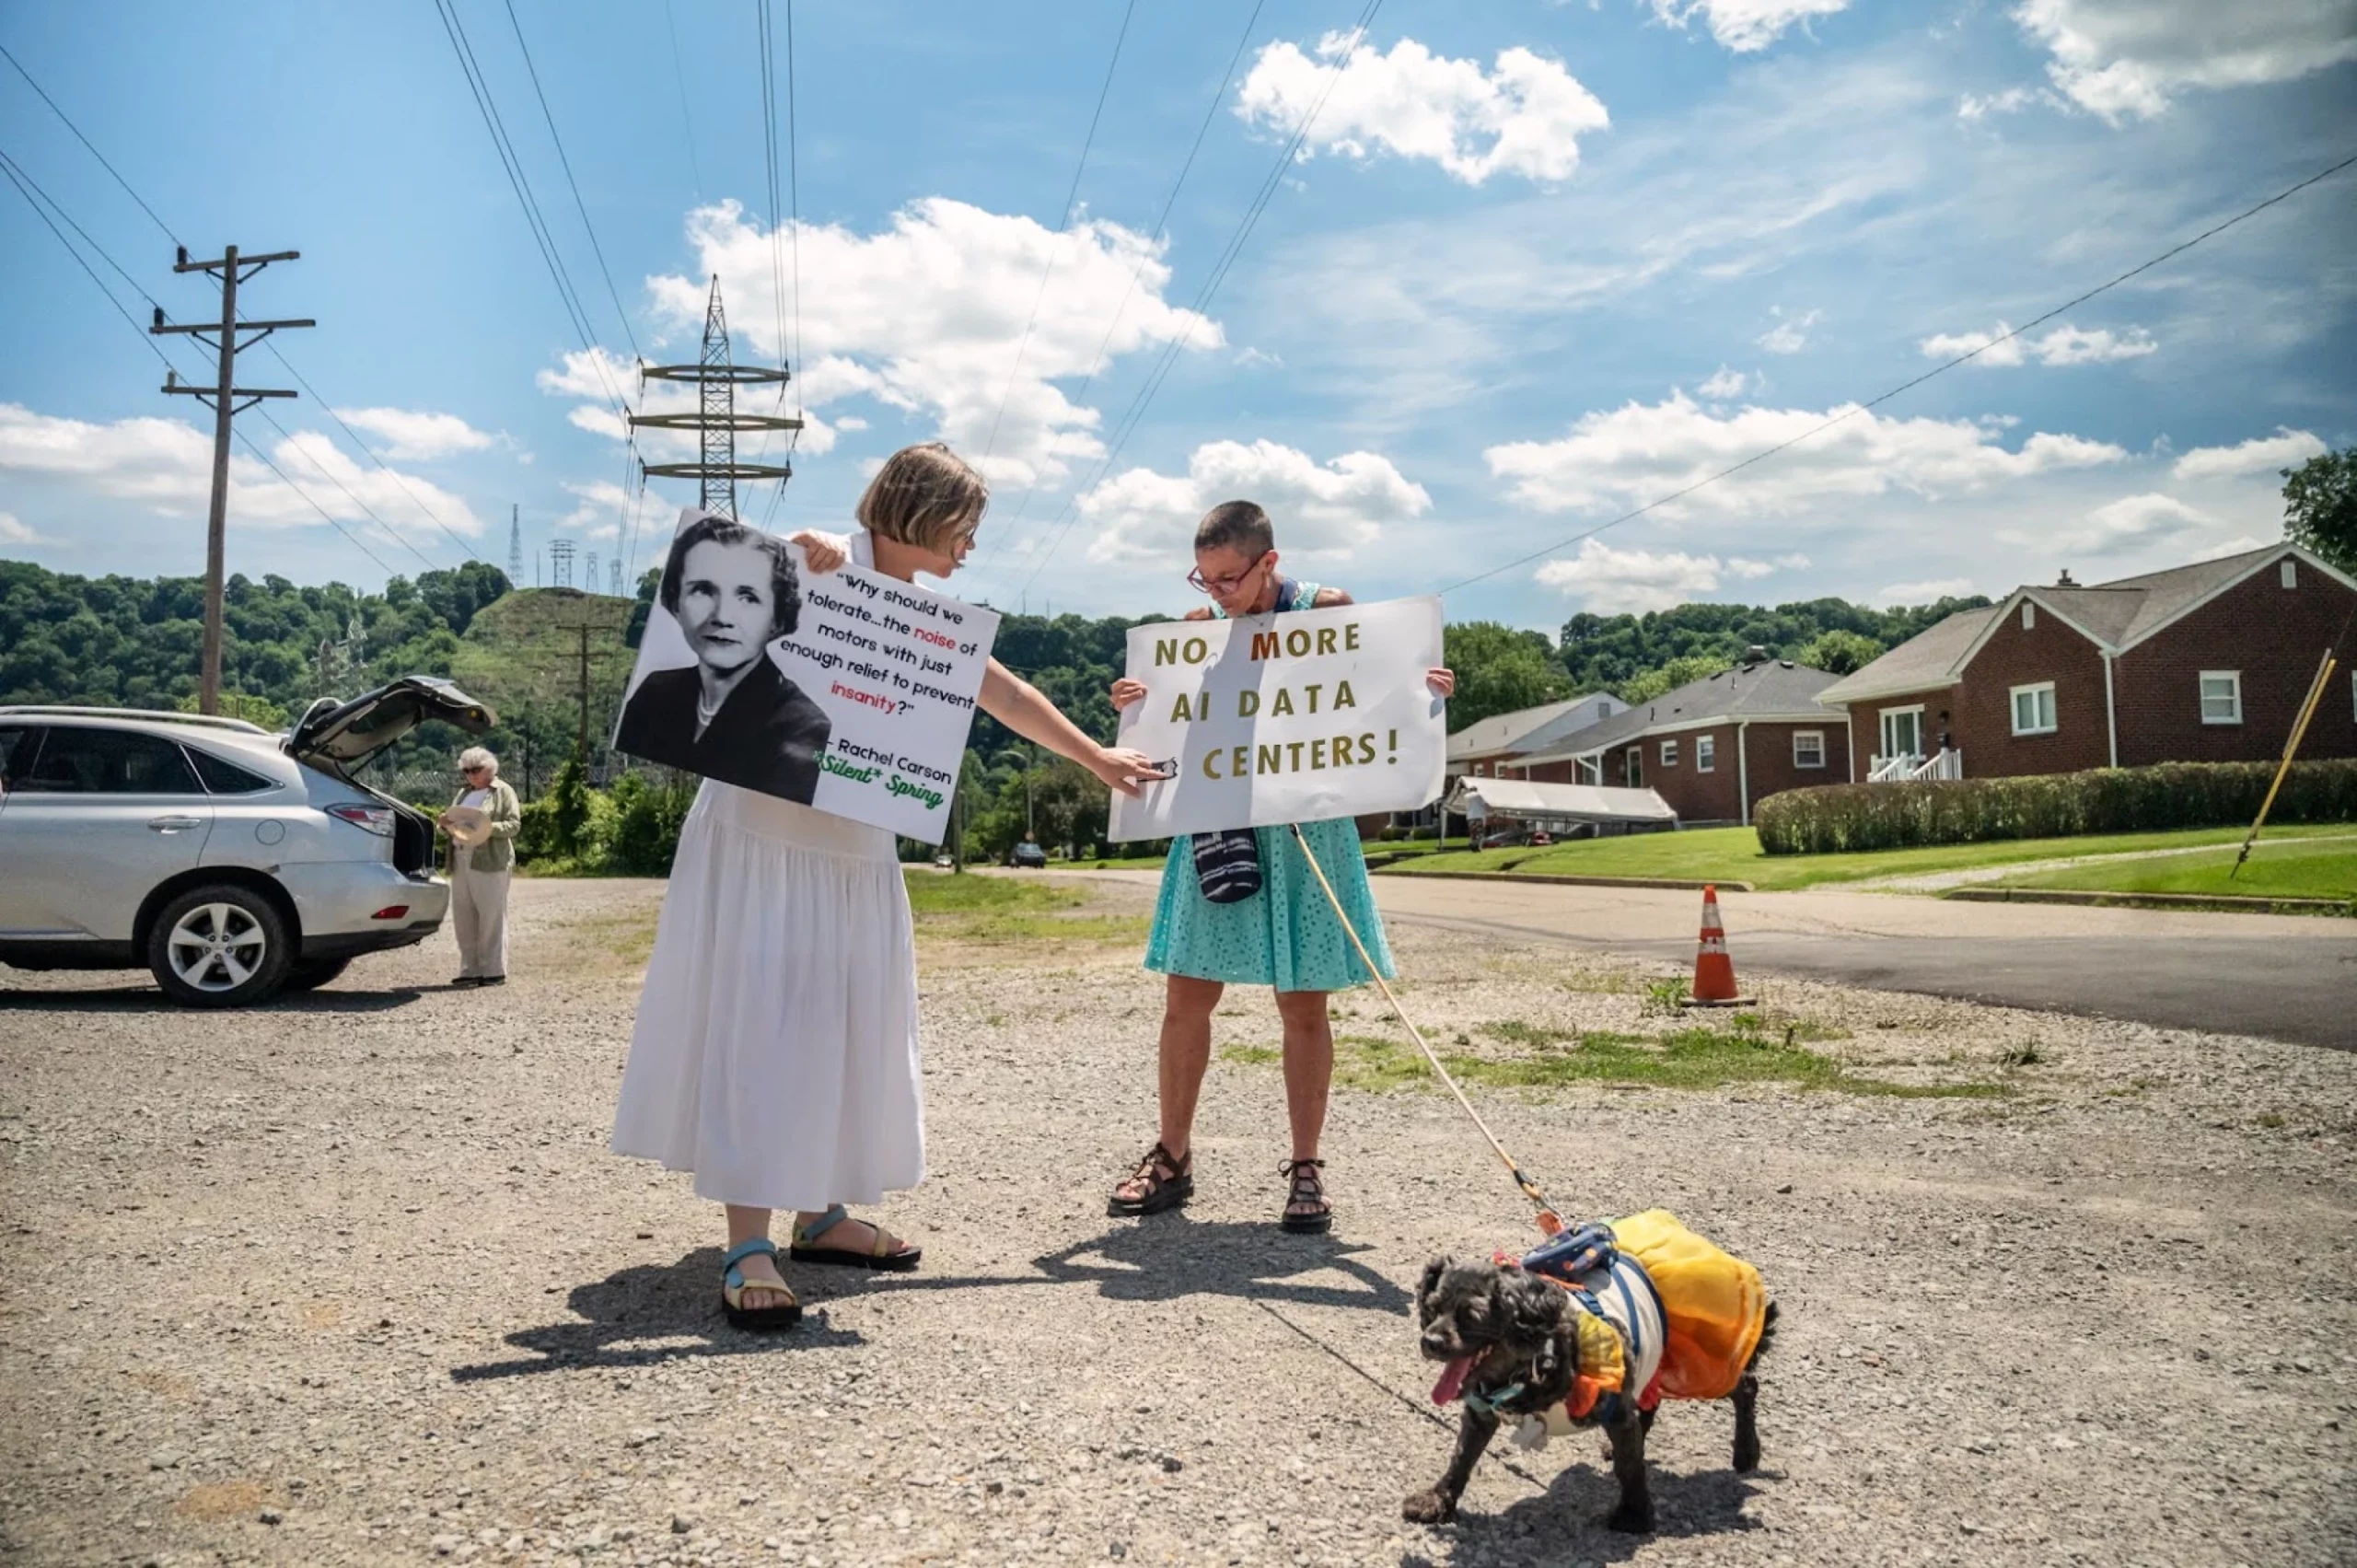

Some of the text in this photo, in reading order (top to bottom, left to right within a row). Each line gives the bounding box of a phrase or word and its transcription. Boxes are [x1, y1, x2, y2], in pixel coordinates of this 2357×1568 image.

[884, 589, 939, 617] should
[942, 608, 963, 625] we
[818, 623, 953, 676] motors with just
[913, 627, 956, 649] noise
[959, 643, 978, 656] of
[1155, 623, 1360, 667] NO MORE
[781, 640, 975, 710] enough relief to prevent
[1170, 680, 1355, 723] AI DATA
[838, 738, 893, 766] Rachel
[897, 757, 952, 784] Carson
[1202, 729, 1397, 780] CENTERS!
[885, 774, 944, 809] Spring
